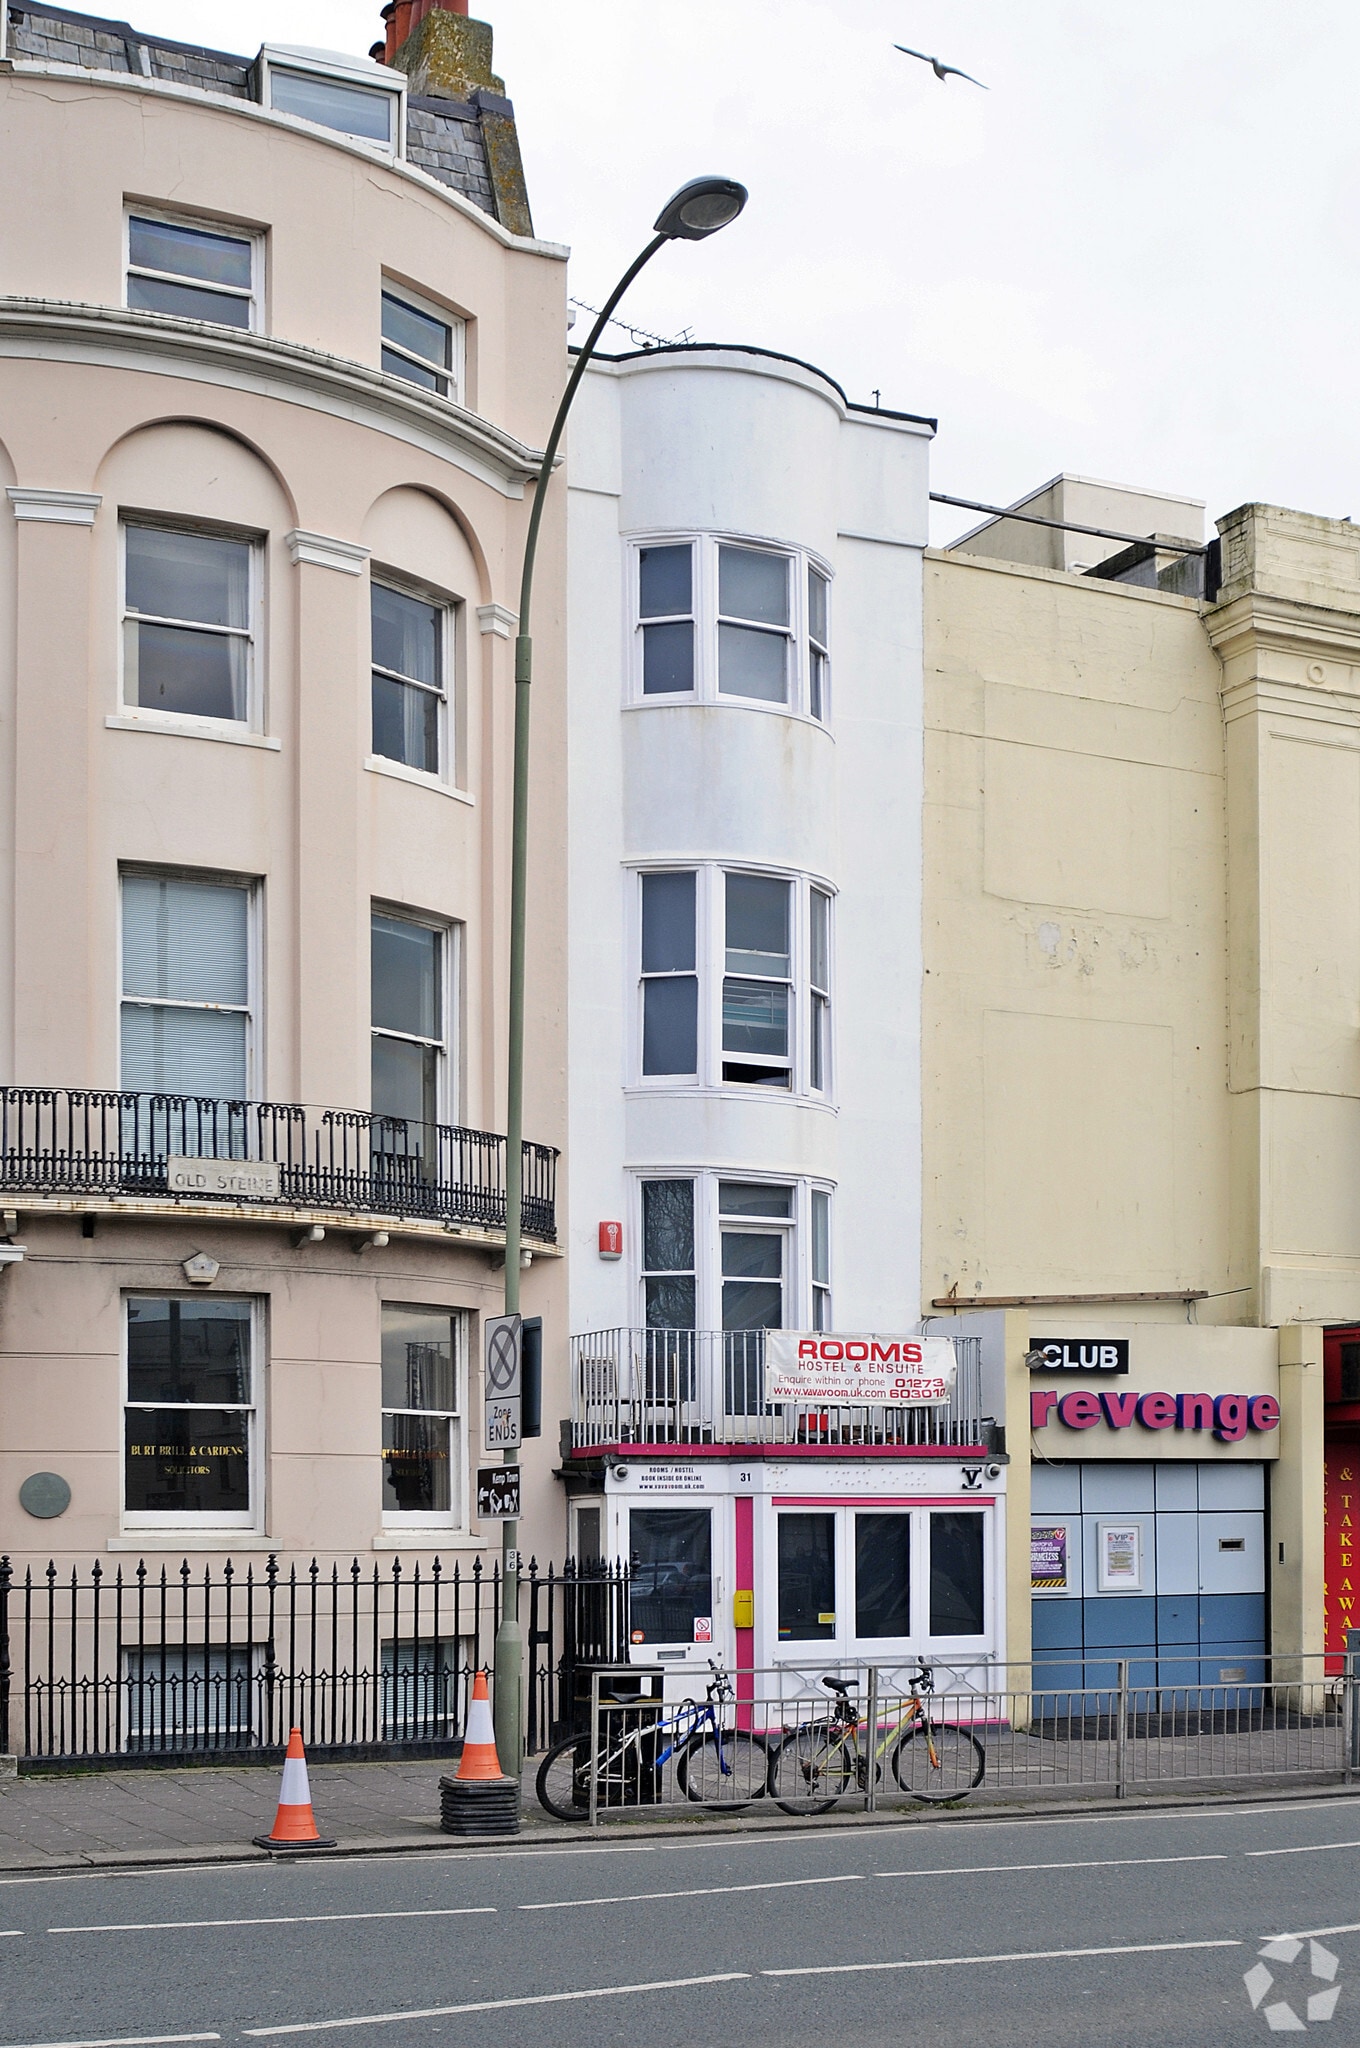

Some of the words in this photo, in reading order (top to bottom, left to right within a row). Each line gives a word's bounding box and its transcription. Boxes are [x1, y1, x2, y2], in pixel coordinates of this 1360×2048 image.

[175, 1173, 206, 1188] OLD
[798, 1340, 923, 1363] ROOMS
[1043, 1345, 1119, 1369] CLUB
[798, 1361, 847, 1373] HOSTEL
[853, 1363, 862, 1373] &
[868, 1363, 924, 1375] ENSUITE
[778, 1374, 812, 1386] Enquire
[815, 1375, 841, 1386] within
[844, 1378, 854, 1386] or
[858, 1377, 886, 1389] phone
[895, 1378, 944, 1388] 01273
[773, 1386, 887, 1398] www.vavavoom.uk.com
[889, 1388, 946, 1399] 603010
[1030, 1390, 1280, 1442] revenge
[489, 1423, 517, 1441] ENDS
[131, 1445, 156, 1456] BURT
[159, 1445, 188, 1456] BRILL
[189, 1445, 197, 1456] &
[199, 1445, 244, 1457] CARDENS
[164, 1465, 211, 1475] SOLICITORS
[740, 1473, 751, 1482] 31
[492, 1472, 506, 1486] Kemp
[506, 1471, 519, 1483] Town
